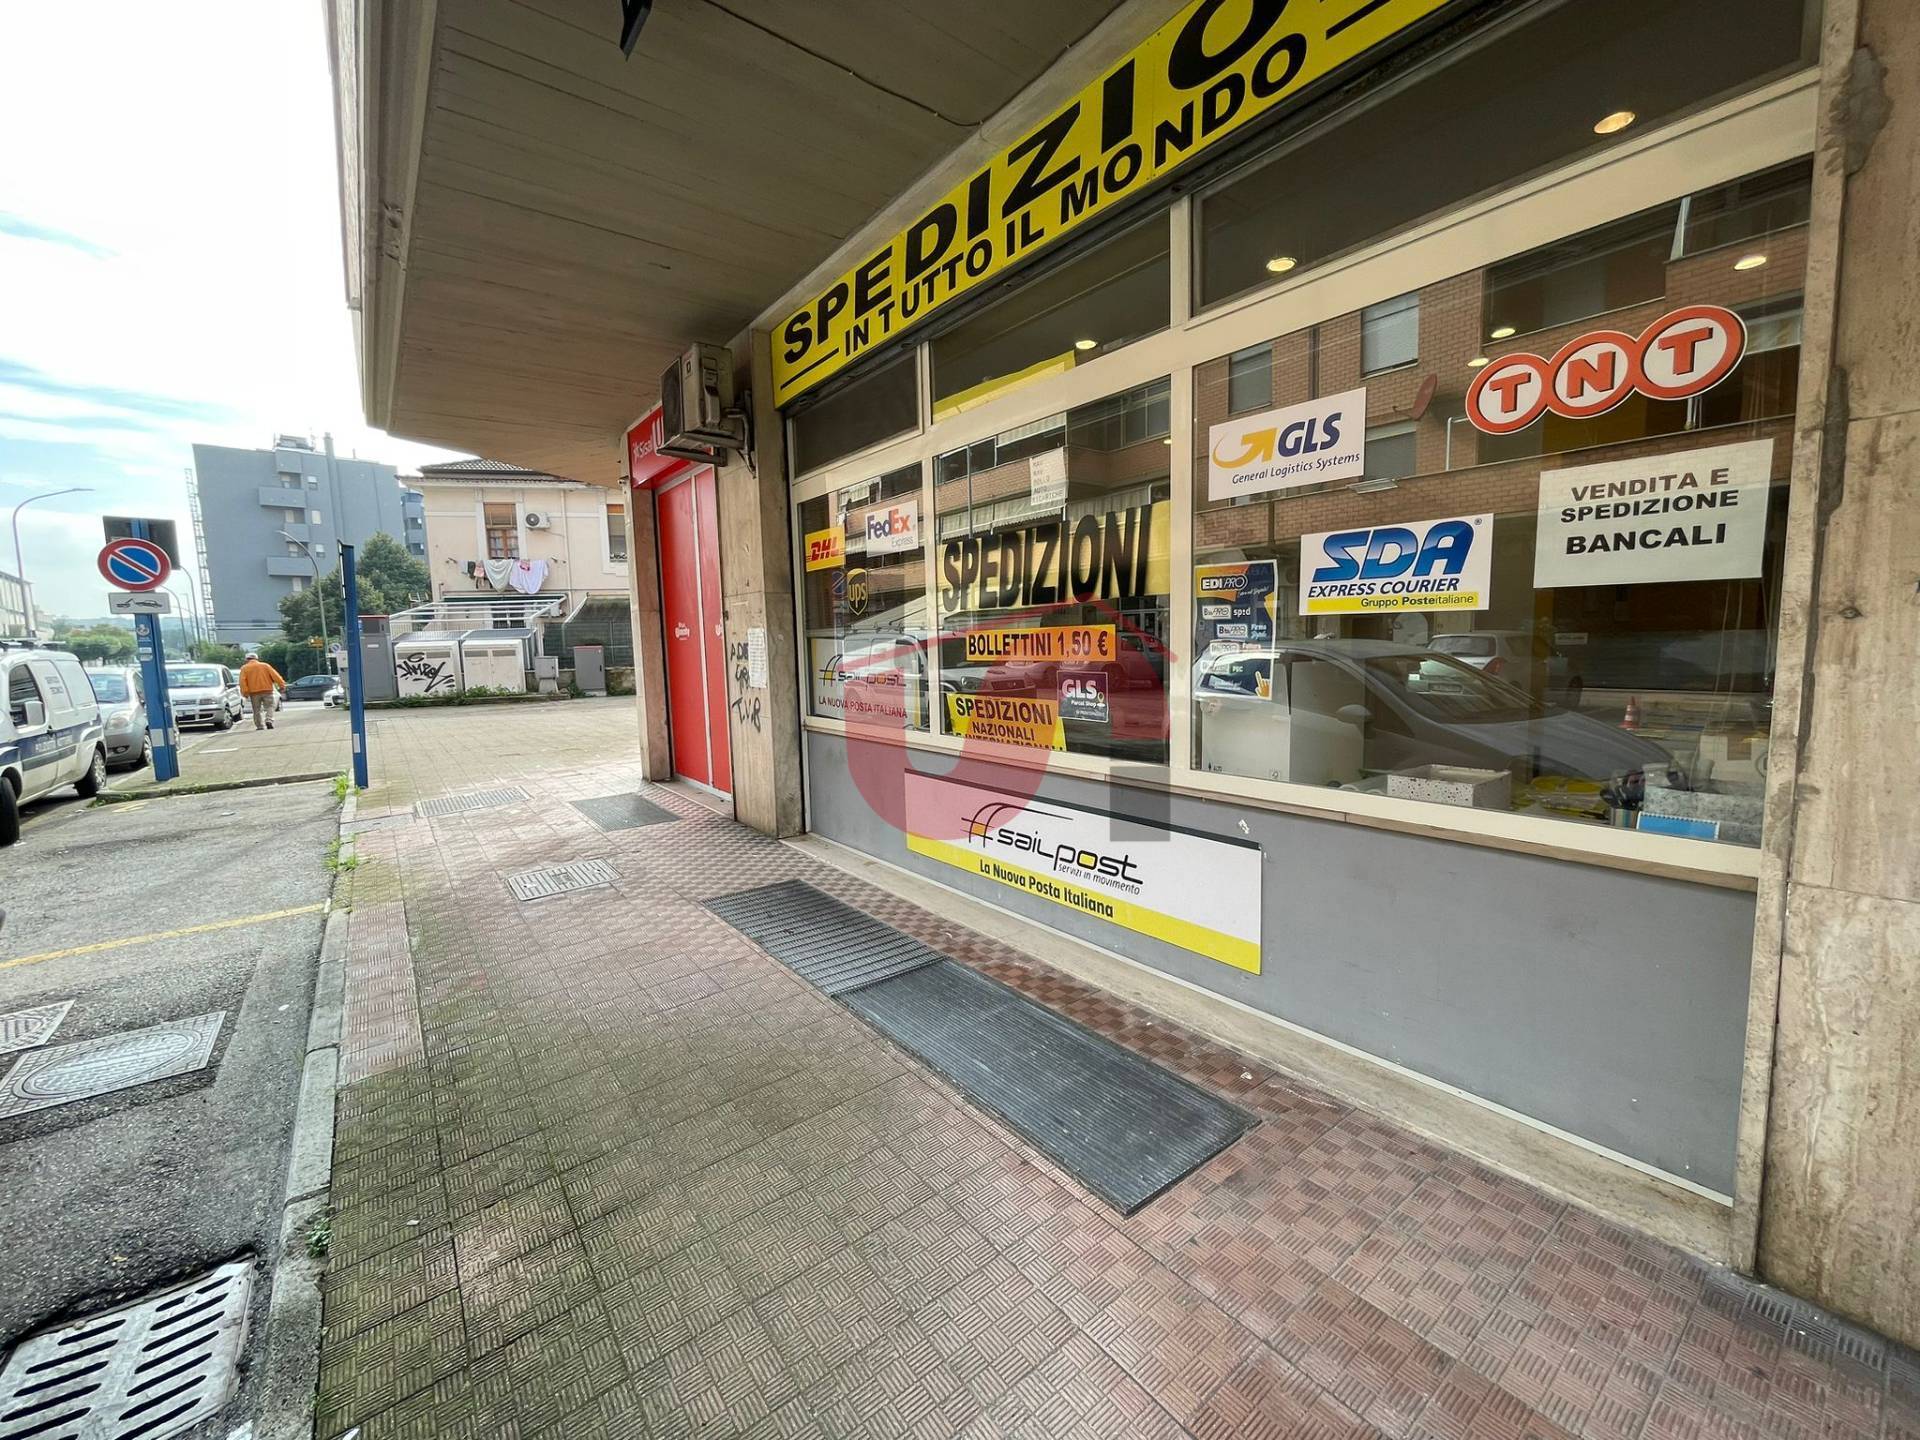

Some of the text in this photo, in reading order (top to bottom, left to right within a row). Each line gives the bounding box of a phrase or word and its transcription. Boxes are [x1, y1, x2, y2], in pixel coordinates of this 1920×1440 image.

[783, 0, 1324, 365] SPEDIZIO
[845, 32, 1307, 356] IN TUTTO IL MONDO
[1489, 326, 1713, 414] TNT
[1277, 411, 1342, 457] GLS
[1232, 452, 1361, 486] General Logistics Systems
[1570, 466, 1730, 502] VENDITA E
[1560, 489, 1740, 524] SPEDIZIONE
[867, 509, 911, 540] FedEx
[1565, 523, 1727, 556] BANCALI
[811, 537, 840, 561] DHL
[942, 506, 1153, 612] SPEDIZIONI
[1312, 520, 1475, 583] SDA
[1308, 576, 1460, 598] EXPRESS COURIER
[1360, 592, 1475, 611] Gruppo Posteitaliane
[968, 630, 1108, 658] BOLLETTINI 1,50 €
[1061, 678, 1097, 700] GLS
[818, 696, 908, 718] LA NUOVA POSTA ITALIANA
[955, 697, 1053, 725] SPEDIZIONI
[972, 721, 1035, 741] NAZIONALI
[979, 858, 1114, 919] La Nuova Posta Italiana
[1058, 863, 1141, 896] servizi in movimento
